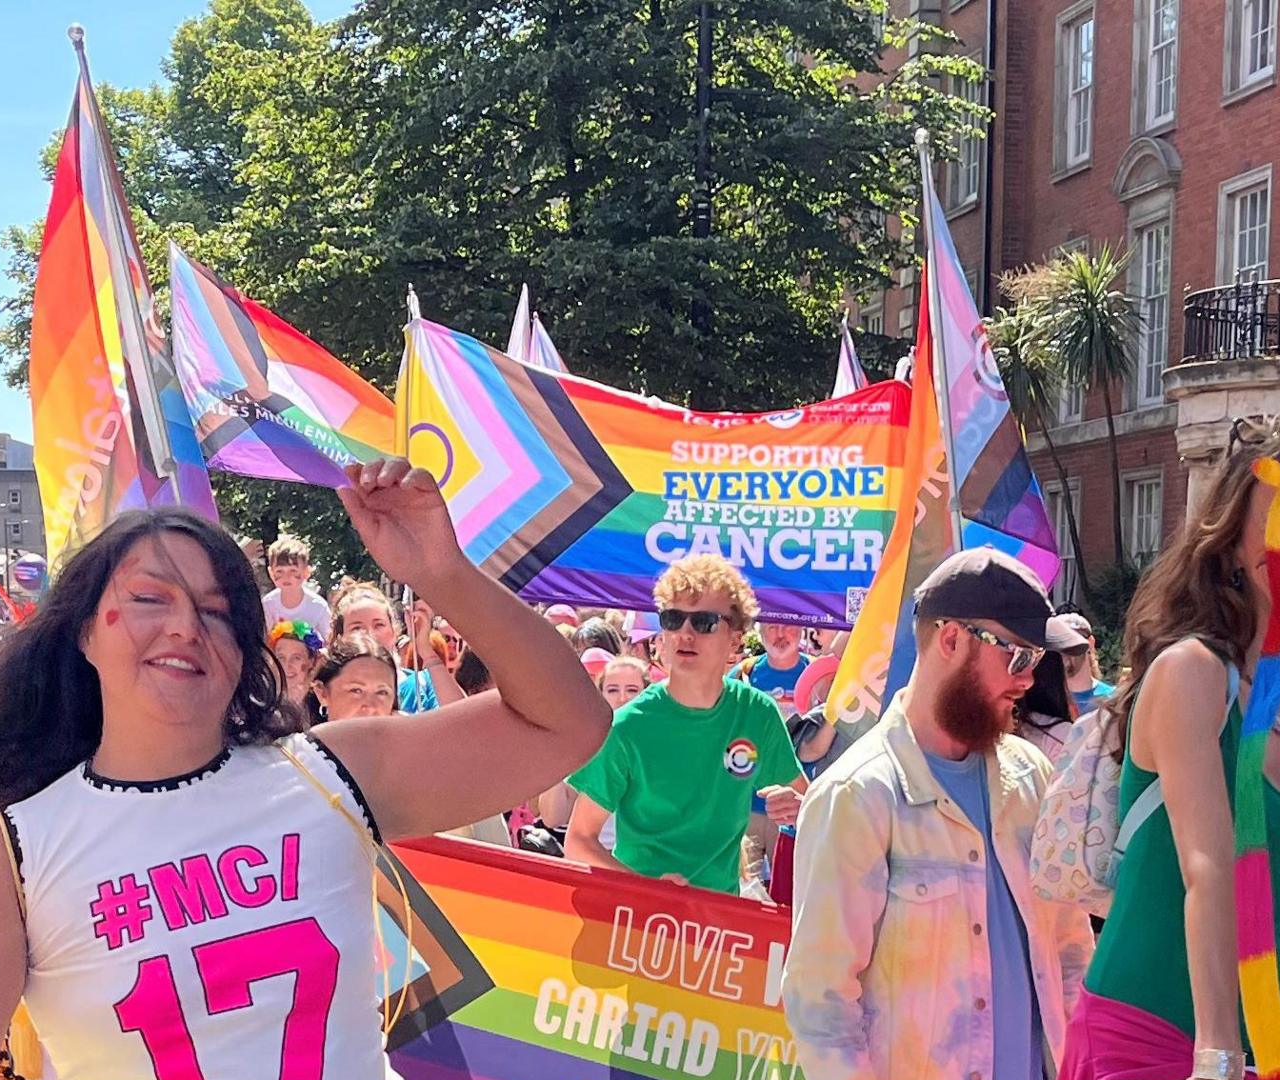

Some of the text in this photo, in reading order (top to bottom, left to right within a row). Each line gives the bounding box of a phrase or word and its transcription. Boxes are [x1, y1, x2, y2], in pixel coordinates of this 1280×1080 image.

[671, 440, 864, 468] SUPPORTING
[662, 466, 885, 500] EVERYONE
[664, 501, 859, 528] AFFECTED BY
[644, 521, 885, 572] CANCER
[608, 905, 754, 1001] LOVE
[533, 977, 719, 1078] CARIAD
